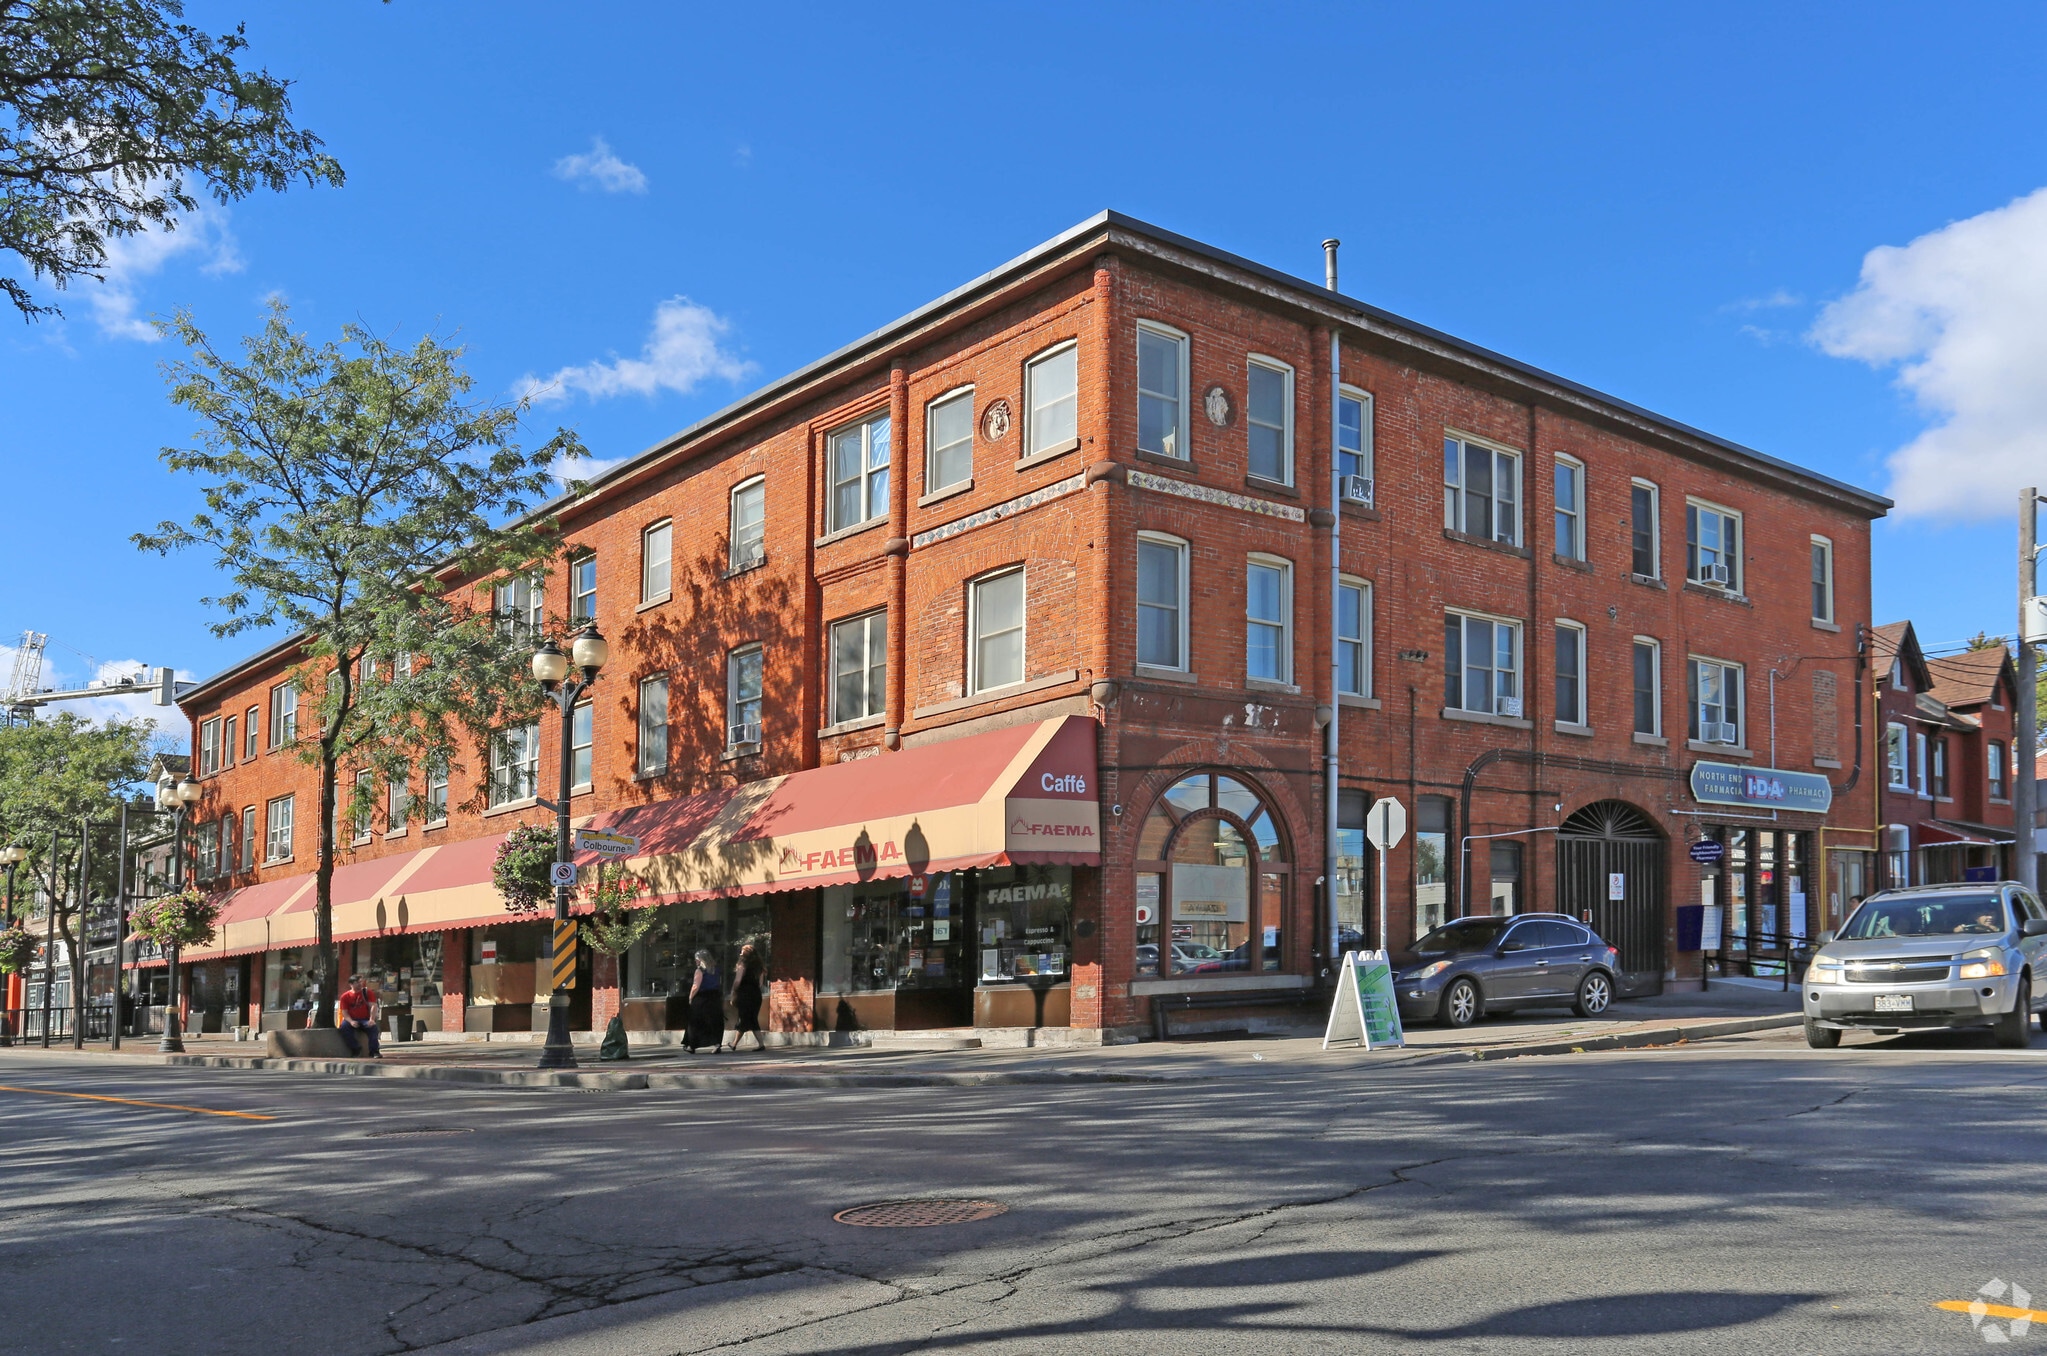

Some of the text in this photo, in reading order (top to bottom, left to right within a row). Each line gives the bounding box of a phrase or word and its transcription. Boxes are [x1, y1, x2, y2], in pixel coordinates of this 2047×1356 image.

[1041, 772, 1086, 794] Caffé
[1699, 771, 1743, 783] NORTH END
[1704, 784, 1743, 796] FARMACIA
[1788, 786, 1826, 798] PHARMACY
[1029, 824, 1095, 837] FAEMA
[583, 841, 626, 853] Colbourne
[801, 841, 903, 871] FAEMA
[987, 883, 1063, 904] FAEMA
[1025, 927, 1049, 935] Espresso
[1024, 937, 1054, 945] Cappuccino
